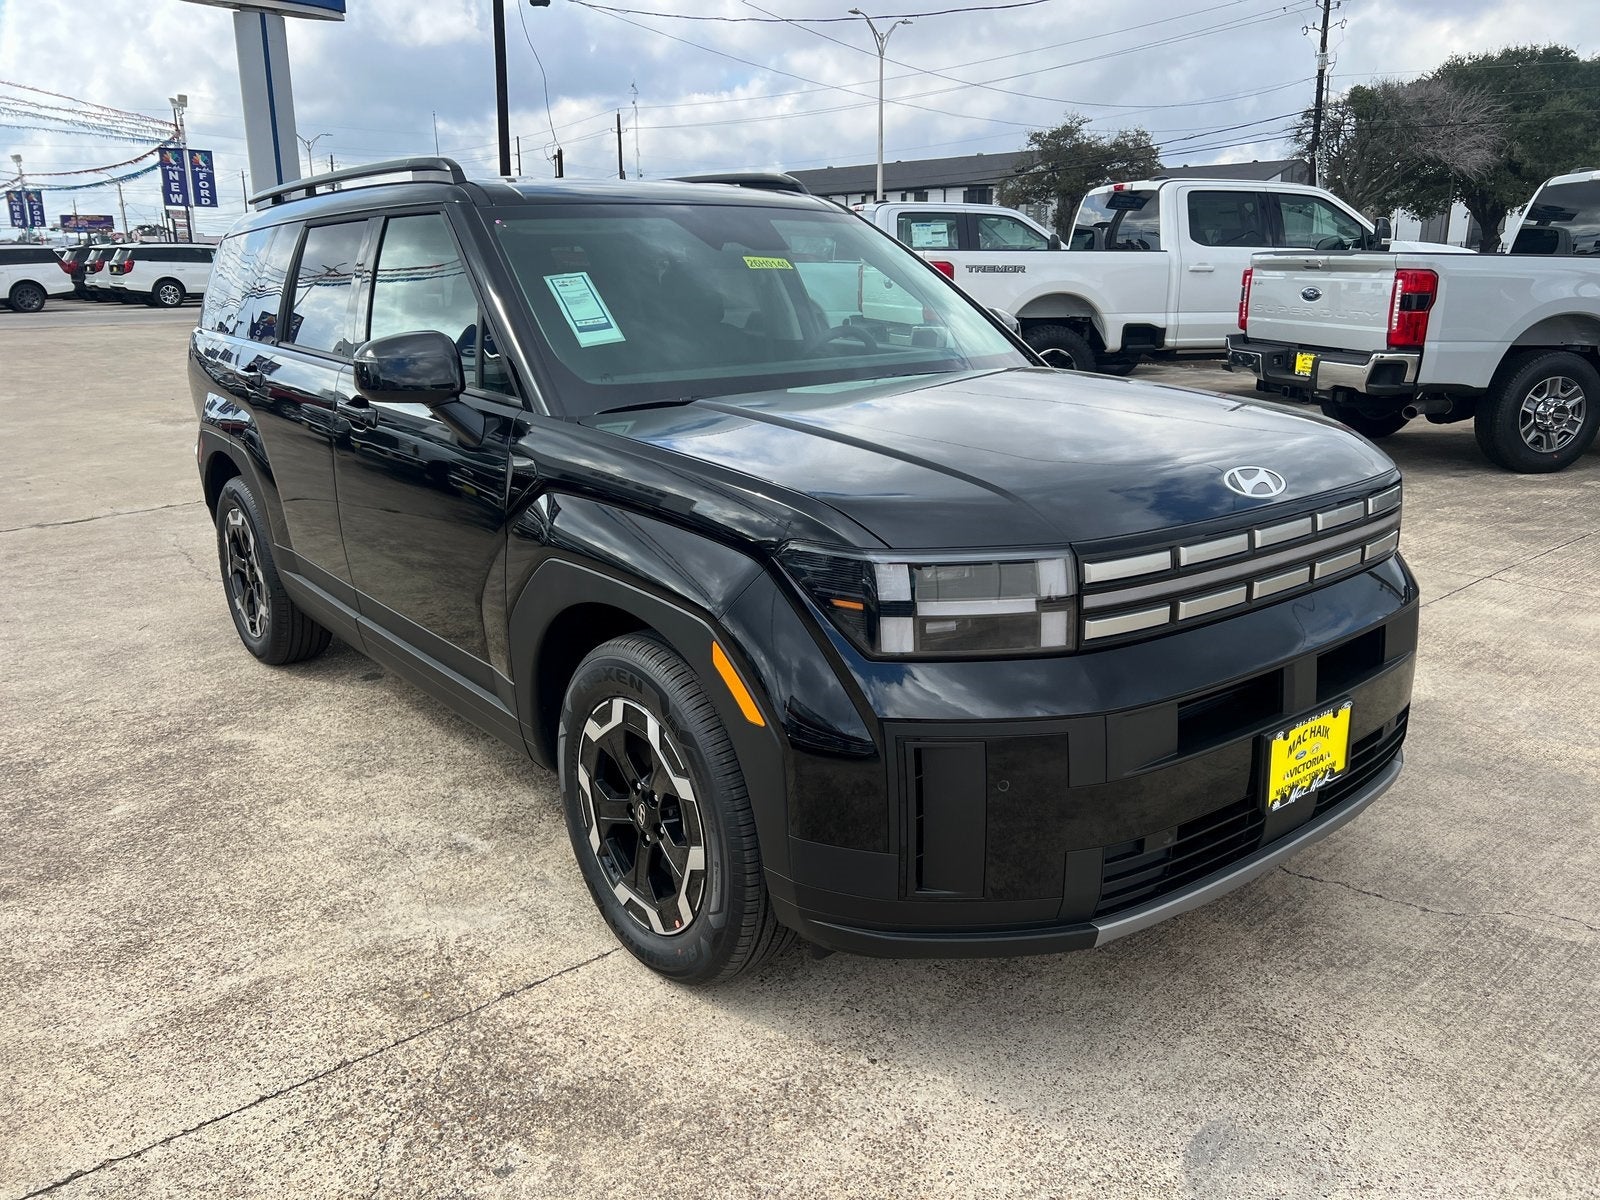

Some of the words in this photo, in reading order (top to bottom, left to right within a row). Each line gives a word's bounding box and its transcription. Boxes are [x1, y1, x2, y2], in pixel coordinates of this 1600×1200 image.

[168, 170, 183, 204] NEW
[198, 172, 211, 205] FORD
[12, 205, 23, 226] NEW
[33, 205, 42, 226] FORD
[965, 264, 1026, 273] TREMOR
[1254, 303, 1314, 317] SUPER
[1319, 309, 1380, 321] DUTY
[1287, 729, 1308, 758] MAC
[1309, 725, 1330, 739] HAIK
[1289, 754, 1325, 777] VICTORIA
[1288, 786, 1310, 803] Mac
